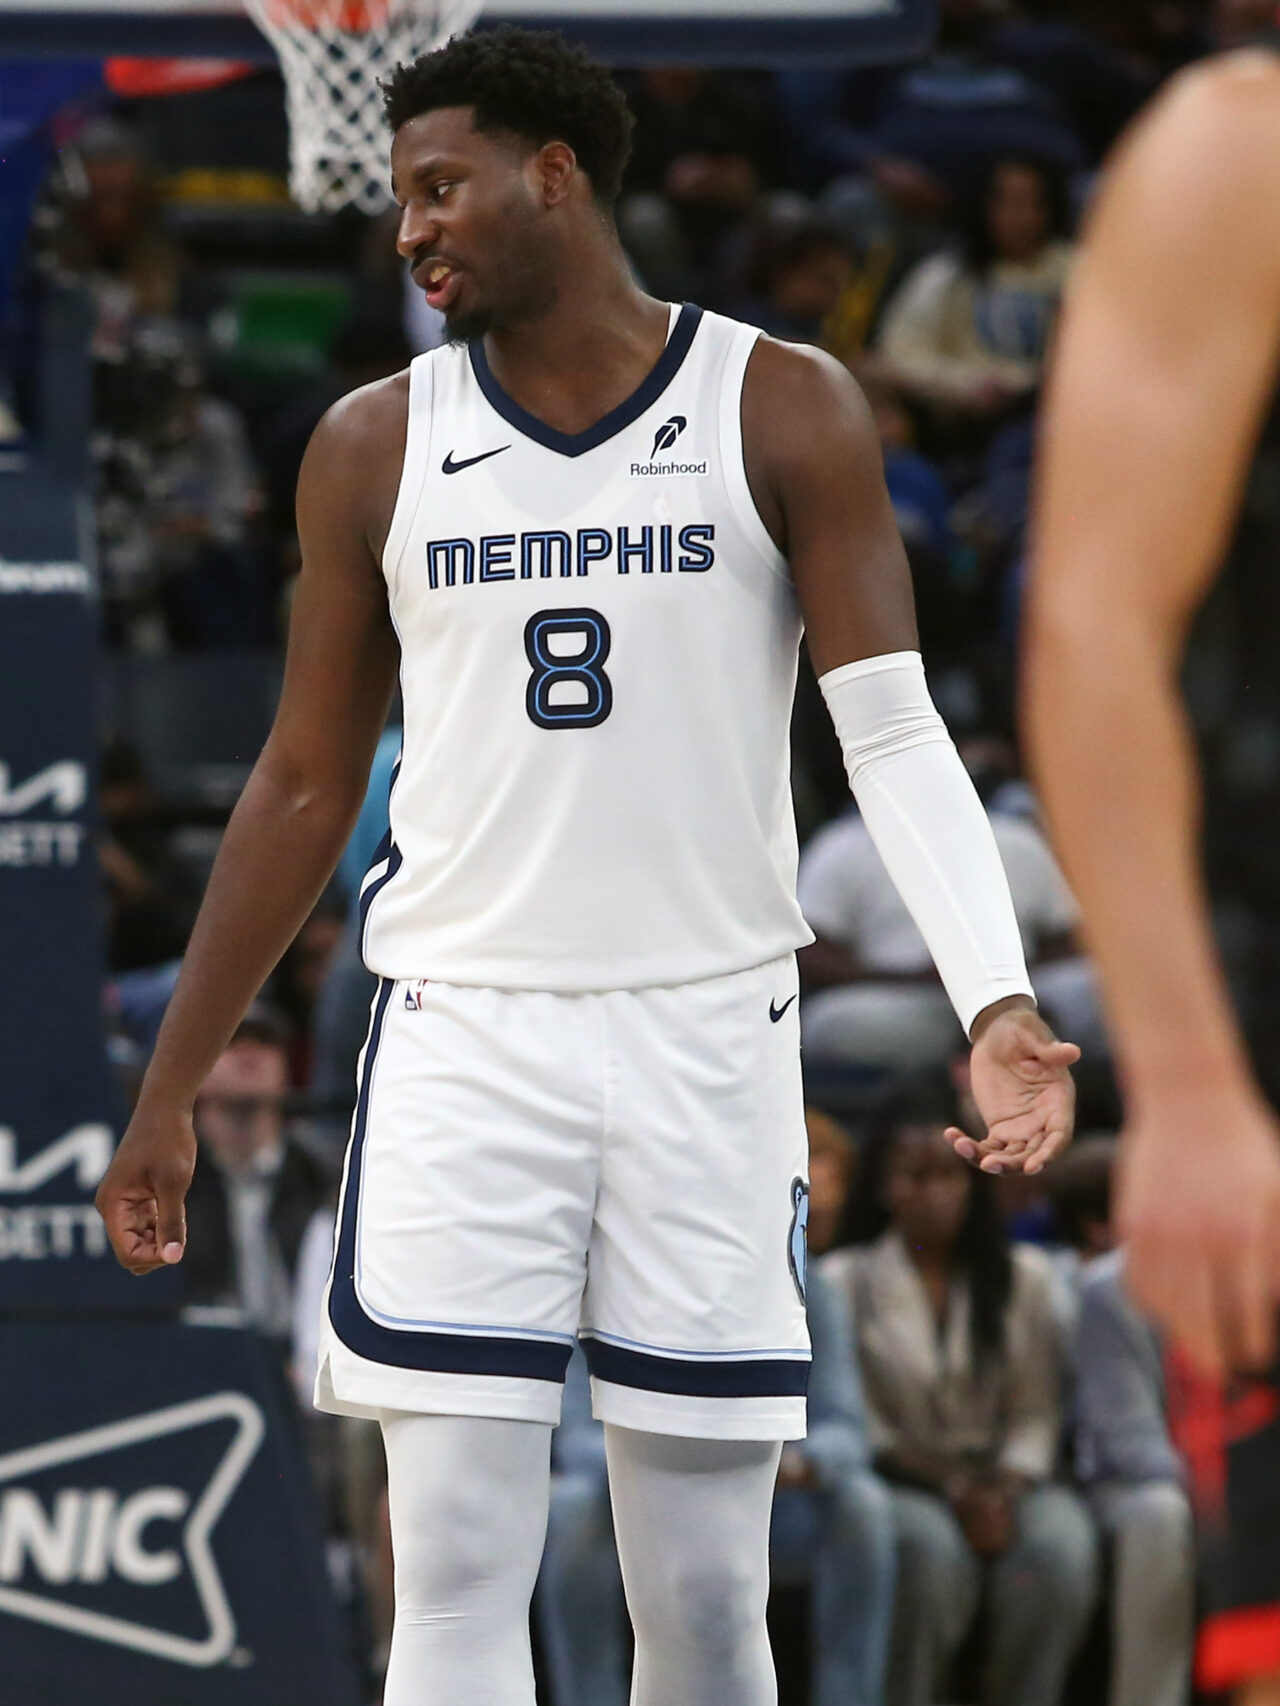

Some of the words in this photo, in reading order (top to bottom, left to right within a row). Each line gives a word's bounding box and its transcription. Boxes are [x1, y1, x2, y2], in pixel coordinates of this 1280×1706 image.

[630, 461, 707, 476] Robinhood
[426, 524, 715, 590] MEMPHIS
[523, 607, 613, 730] 8
